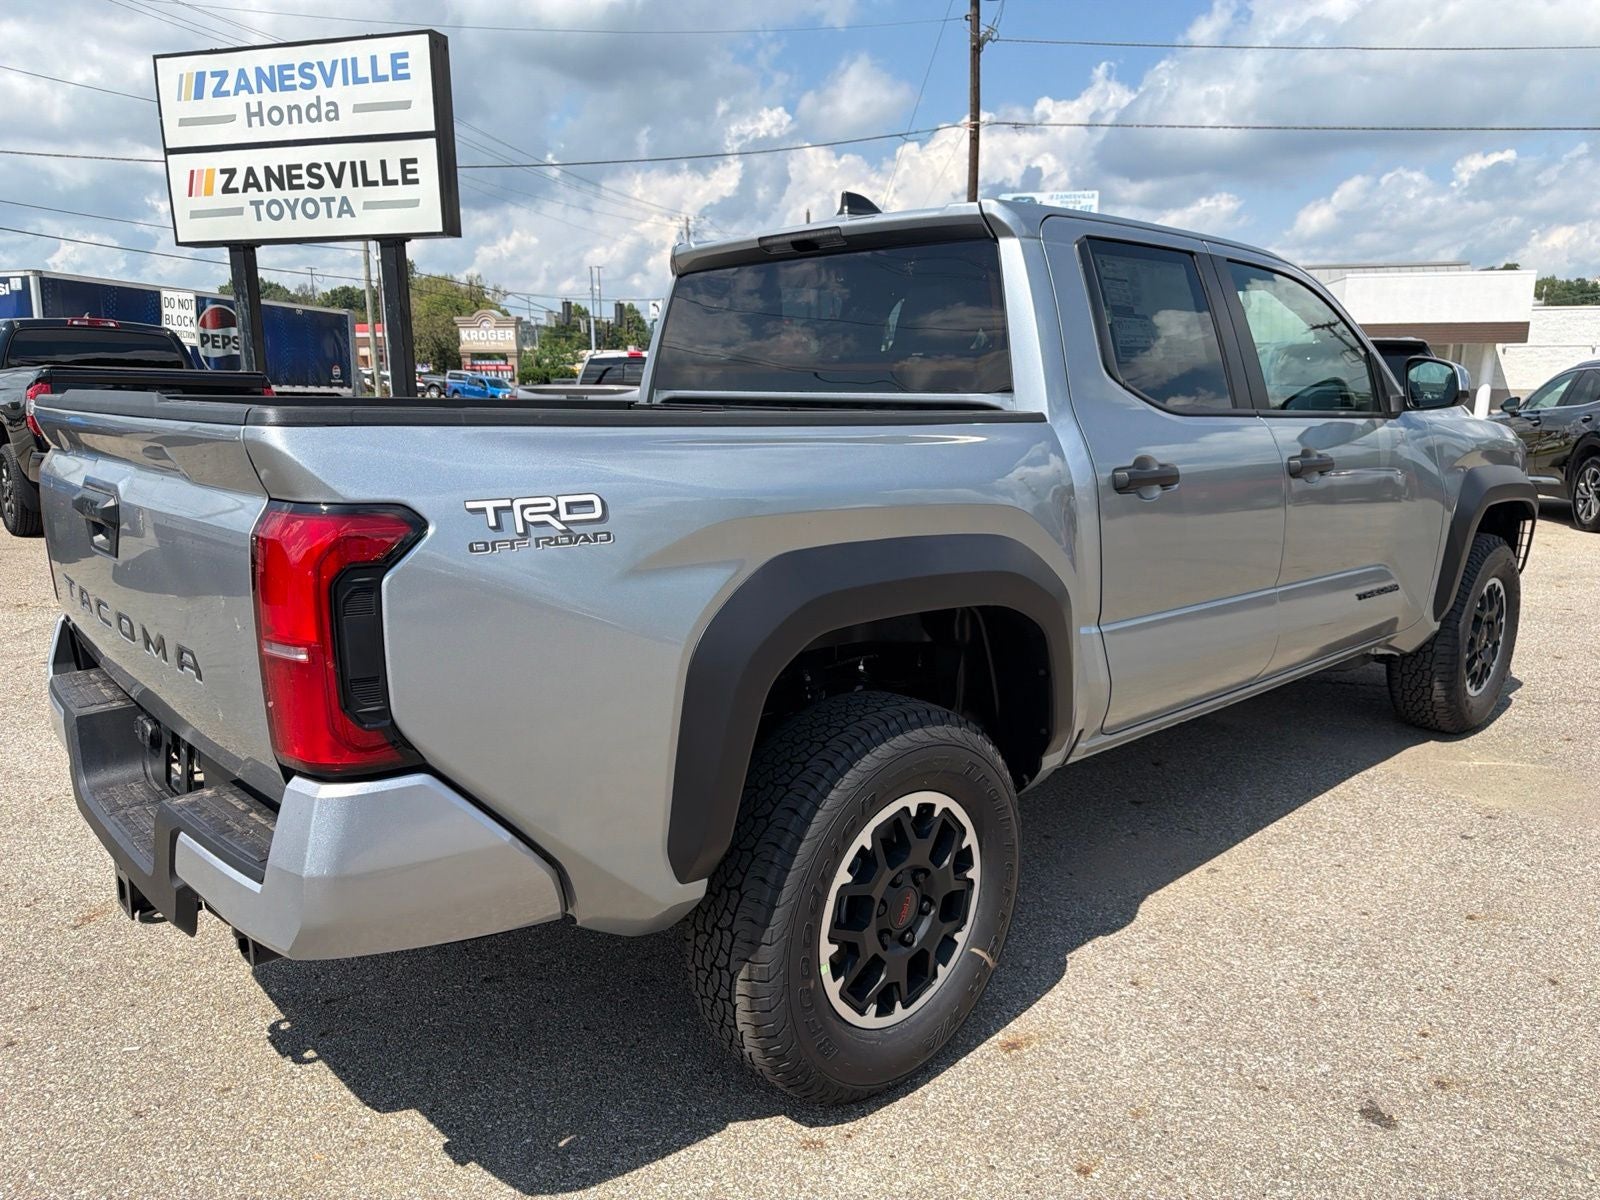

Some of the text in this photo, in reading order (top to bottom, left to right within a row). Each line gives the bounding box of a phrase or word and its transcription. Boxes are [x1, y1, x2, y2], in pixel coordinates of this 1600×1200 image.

[210, 51, 411, 98] ZANESVILLE
[245, 95, 340, 128] Honda
[219, 157, 420, 195] ZANESVILLE
[249, 195, 356, 222] TOYOTA
[163, 296, 194, 311] DO NOT
[164, 313, 195, 328] BLOCK
[200, 332, 241, 351] PEPS
[461, 329, 514, 341] KROGER
[464, 492, 609, 538] TRD
[468, 531, 615, 555] OFF ROAD
[63, 572, 203, 685] TACOMA
